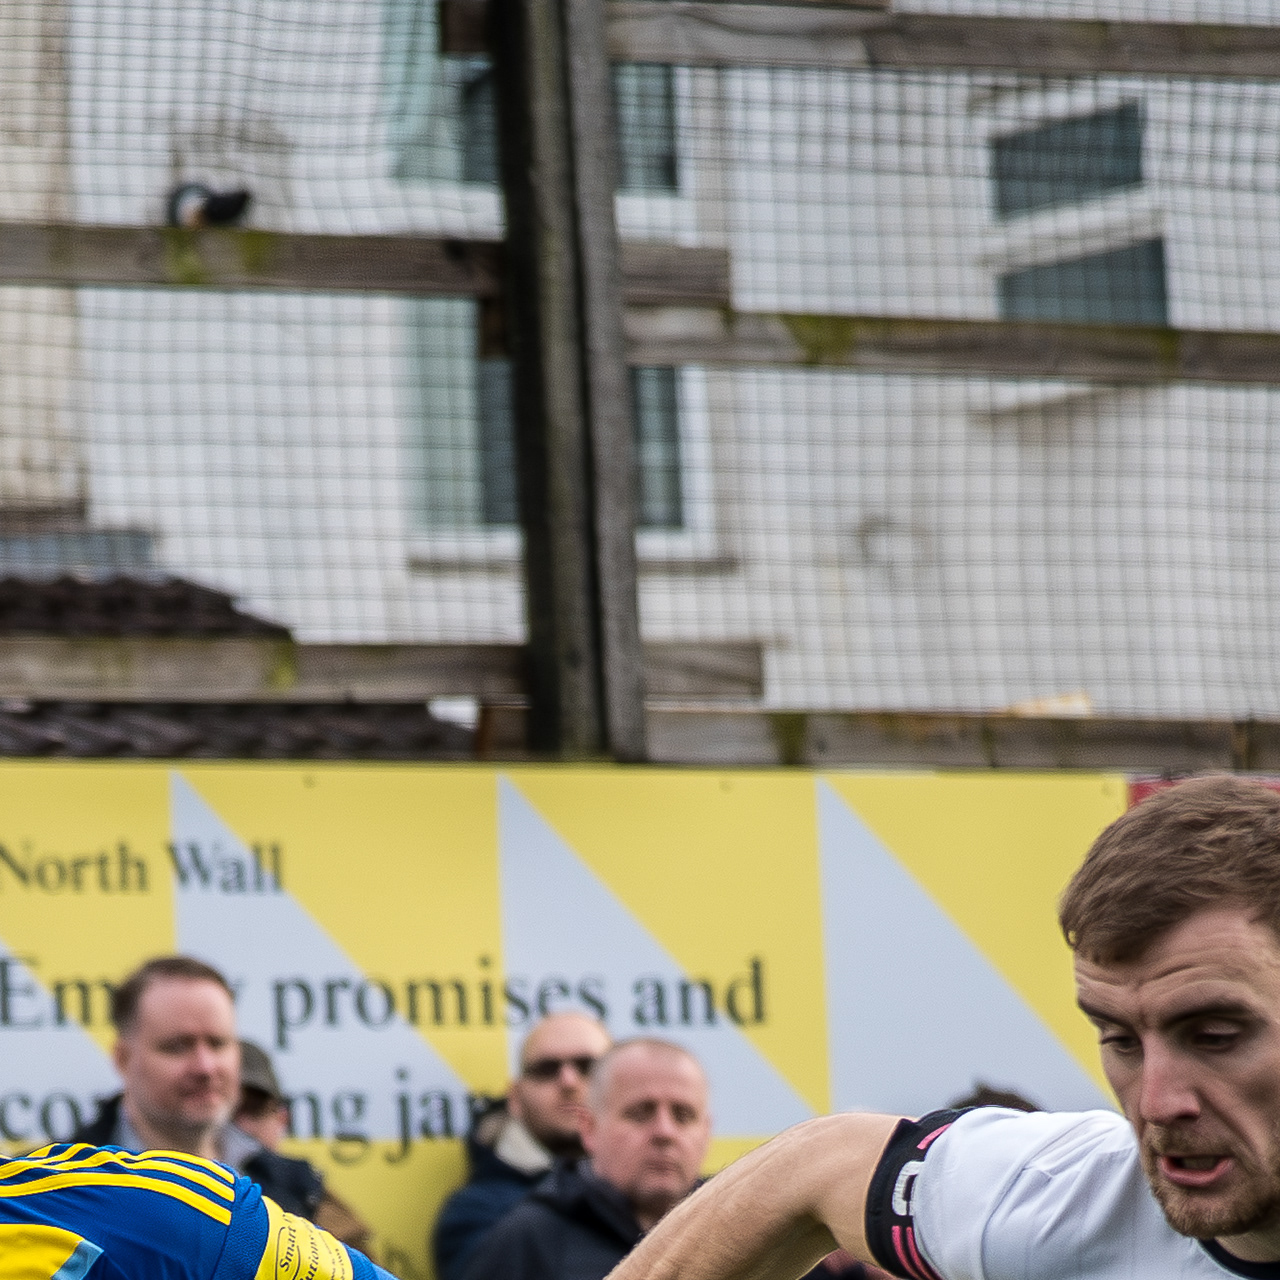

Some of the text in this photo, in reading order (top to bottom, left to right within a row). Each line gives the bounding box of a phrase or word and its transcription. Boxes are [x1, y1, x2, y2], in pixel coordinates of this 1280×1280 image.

[166, 840, 283, 893] Wall
[272, 954, 608, 1050] promises
[632, 955, 767, 1027] and
